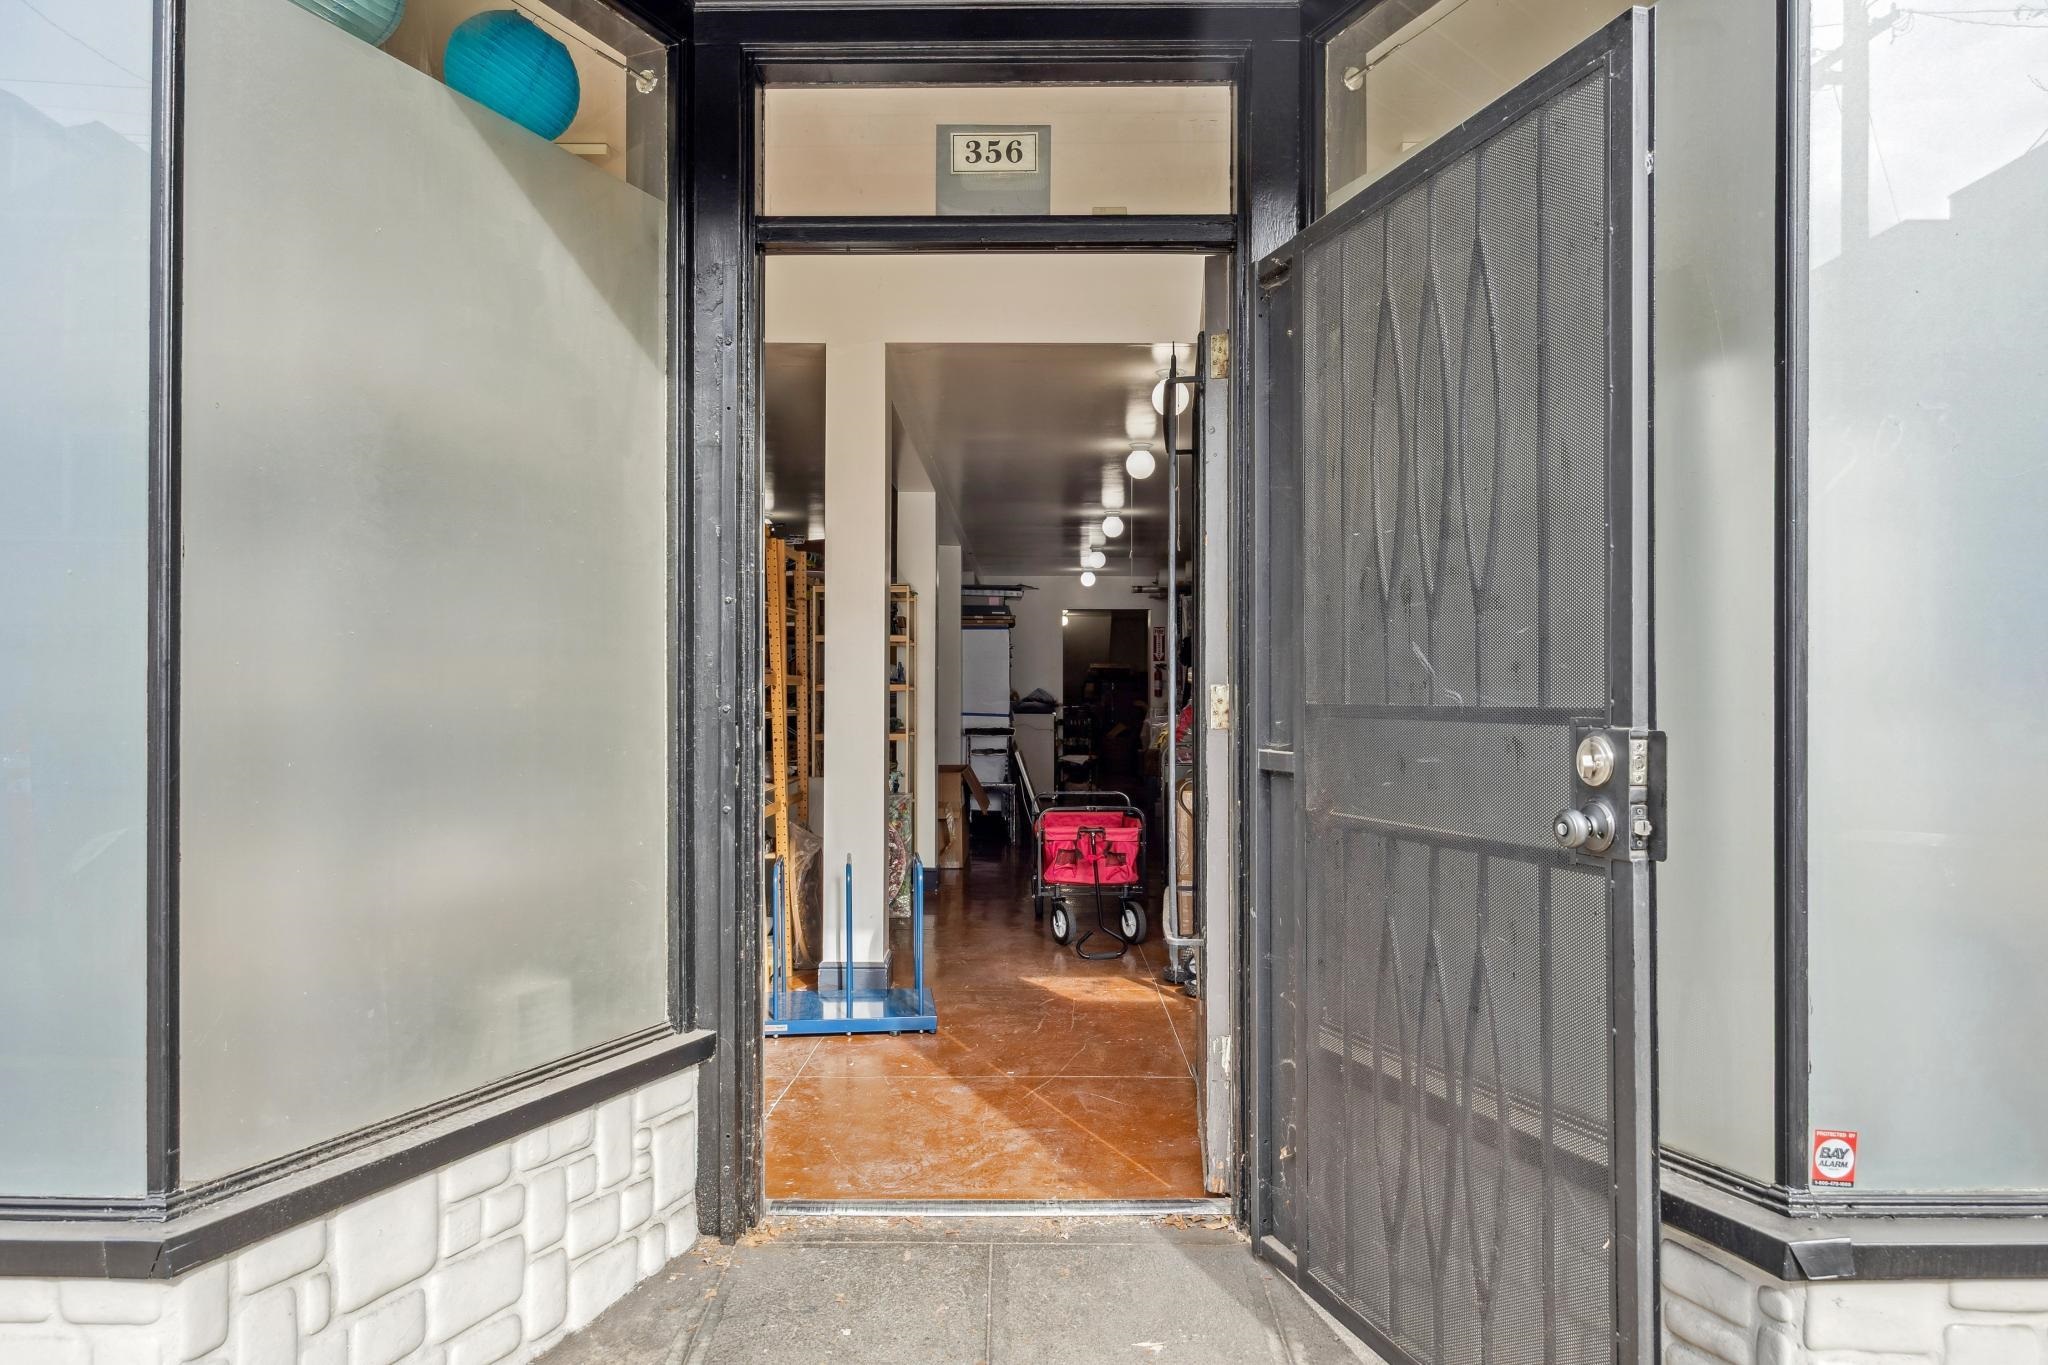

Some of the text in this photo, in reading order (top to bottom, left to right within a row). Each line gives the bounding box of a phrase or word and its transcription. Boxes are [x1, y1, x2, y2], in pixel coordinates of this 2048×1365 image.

[965, 140, 1023, 164] 356
[1819, 1147, 1849, 1159] BAY
[1818, 1160, 1849, 1168] ALARM
